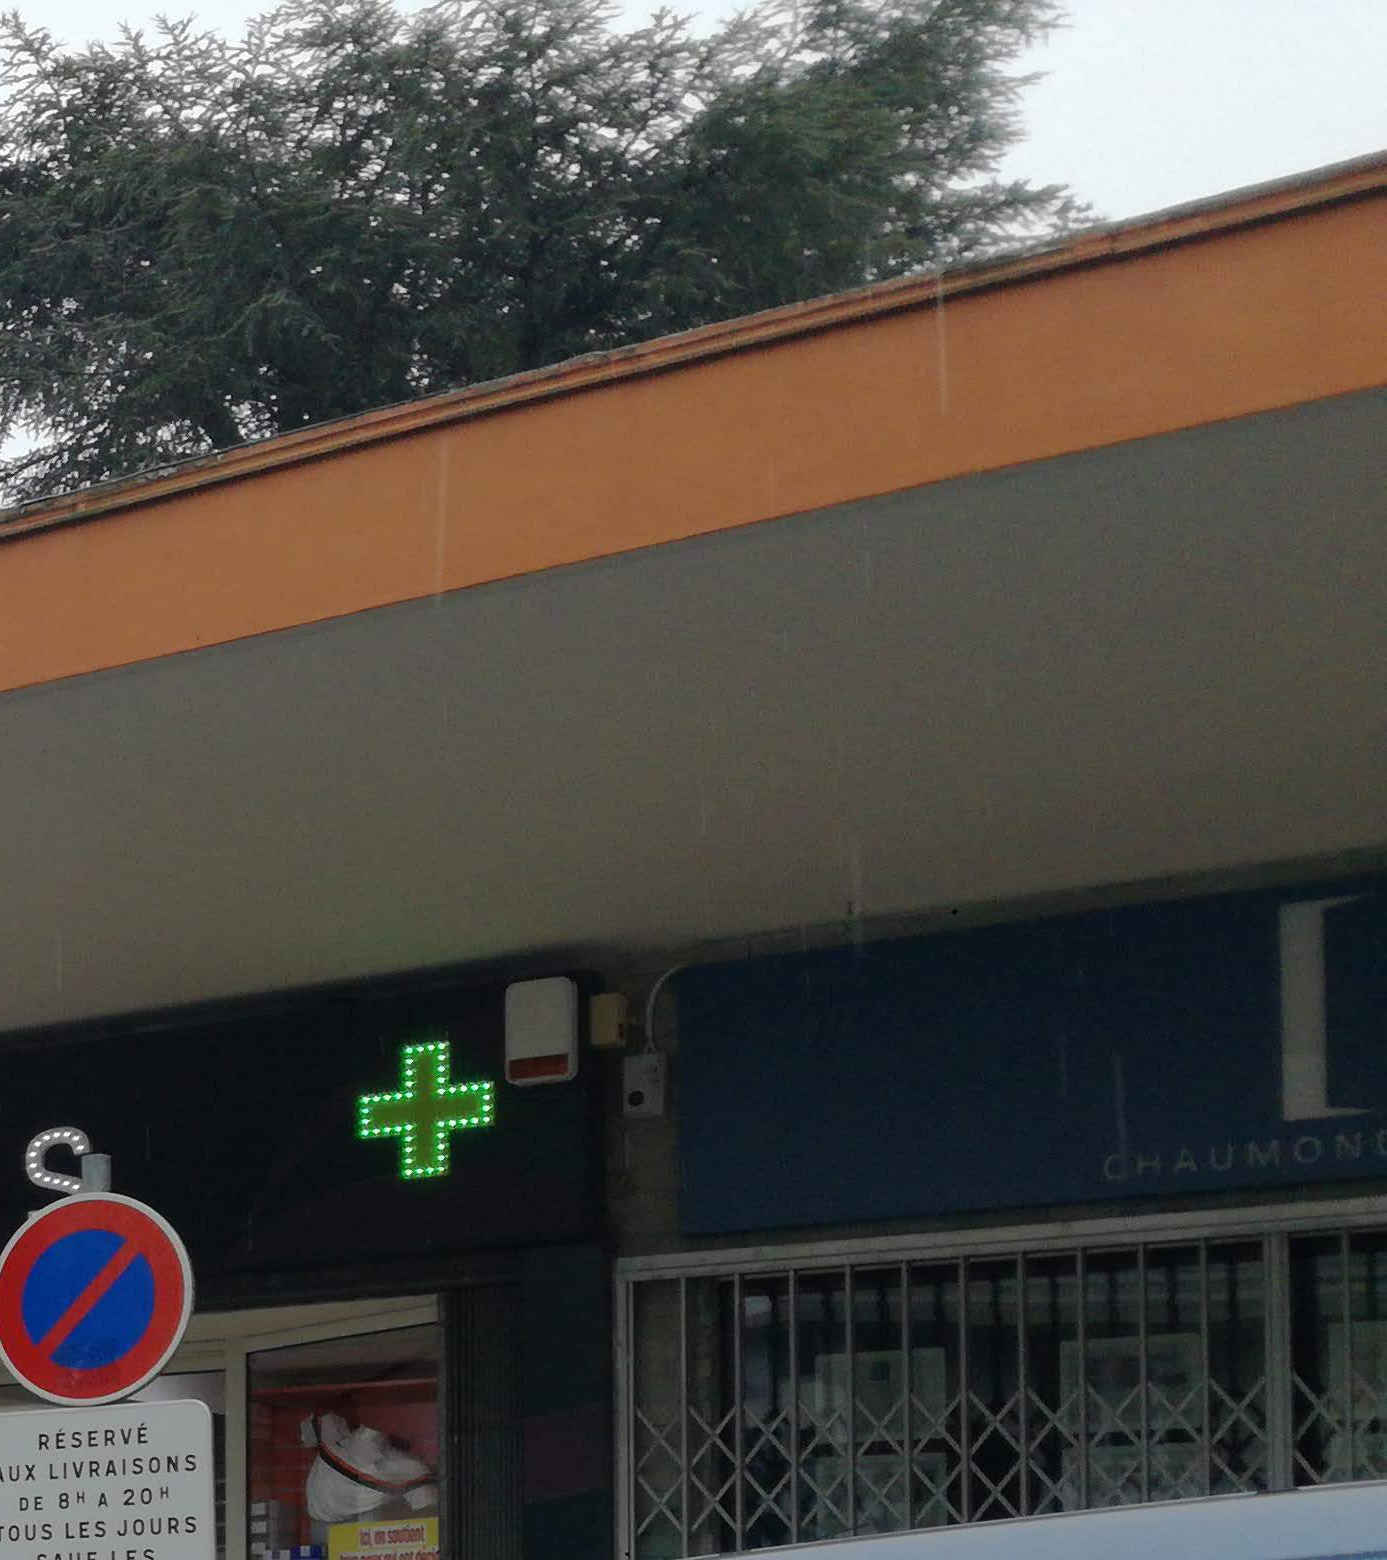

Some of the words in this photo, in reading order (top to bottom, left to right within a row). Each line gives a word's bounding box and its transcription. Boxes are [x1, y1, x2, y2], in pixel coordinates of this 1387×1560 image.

[38, 1423, 149, 1450] RÉSERVÉ
[49, 1454, 198, 1480] LIVRAISONS
[19, 1496, 44, 1511] DE
[98, 1492, 108, 1507] A
[65, 1521, 107, 1540] LES
[117, 1516, 198, 1537] JOURS
